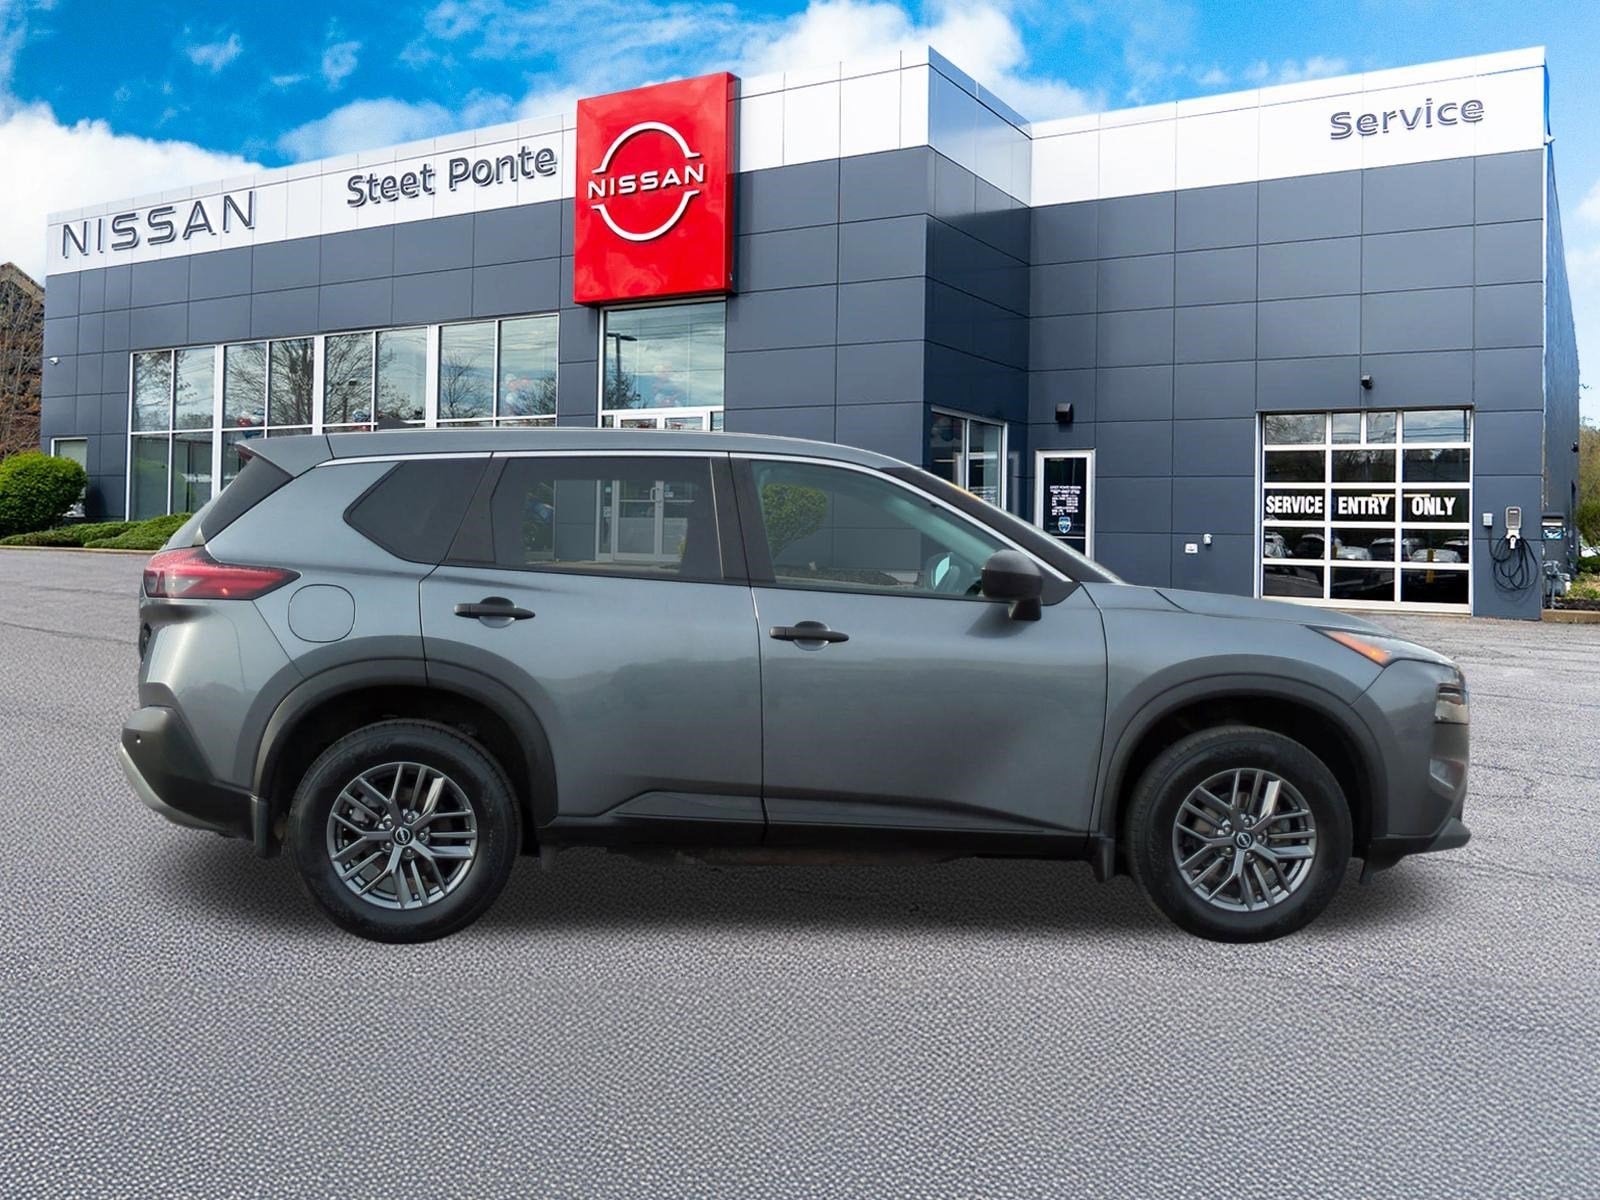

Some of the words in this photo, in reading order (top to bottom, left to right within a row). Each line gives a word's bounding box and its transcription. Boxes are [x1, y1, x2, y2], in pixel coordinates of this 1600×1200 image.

[1330, 97, 1484, 141] Service
[346, 161, 436, 207] Steet
[448, 144, 558, 191] Ponte
[587, 163, 705, 200] NISSAN
[62, 190, 256, 258] NISSAN
[1265, 495, 1324, 514] SERVICE
[1337, 495, 1391, 516] ENTRY
[1411, 495, 1457, 517] ONLY
